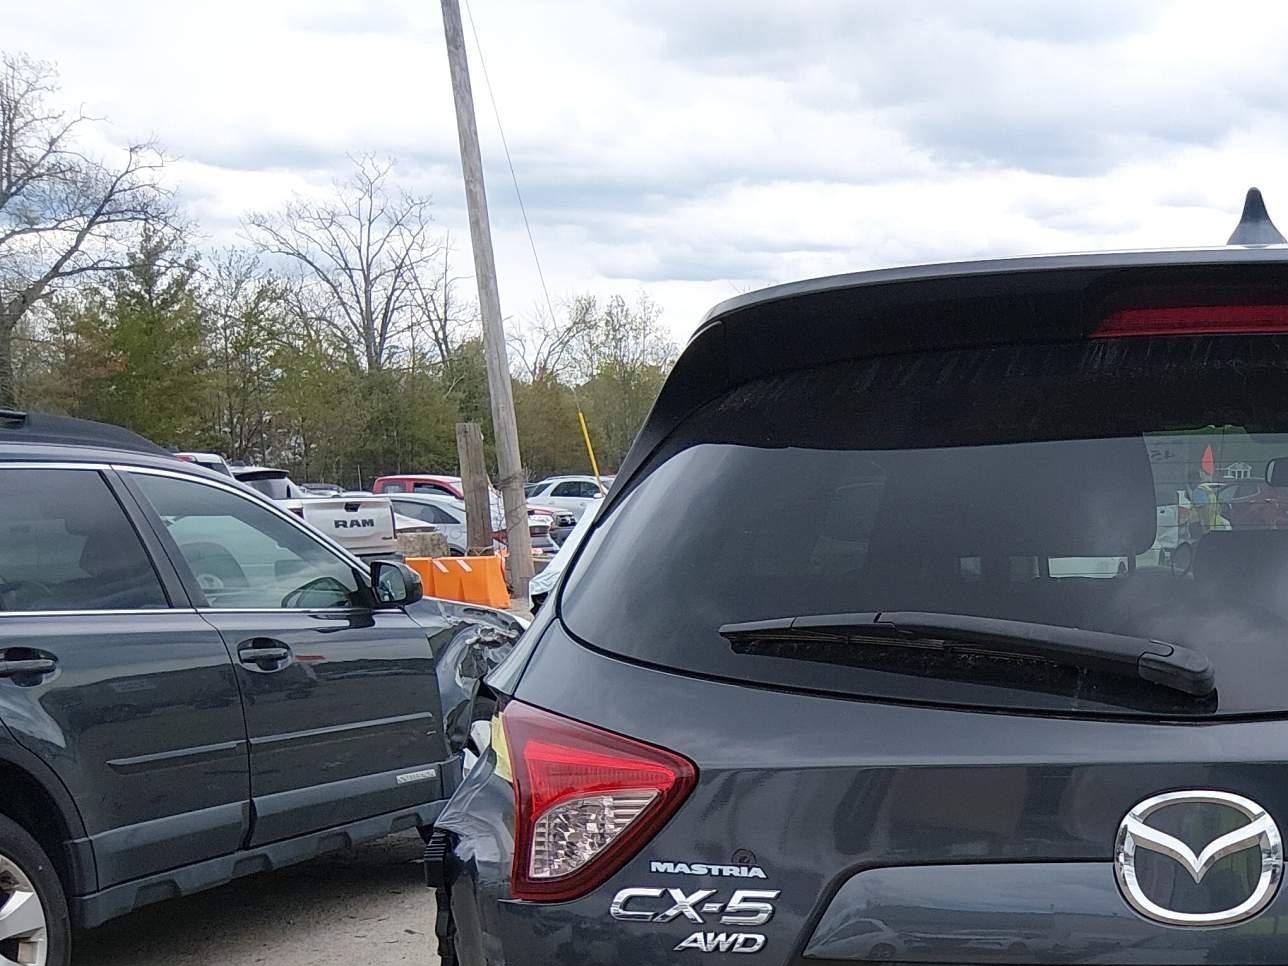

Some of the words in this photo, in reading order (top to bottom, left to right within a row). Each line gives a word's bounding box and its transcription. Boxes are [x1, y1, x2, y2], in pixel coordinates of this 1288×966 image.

[334, 519, 374, 528] RAM
[650, 861, 767, 879] MASTRIA
[610, 887, 782, 926] CX-5
[673, 931, 767, 953] AWD
